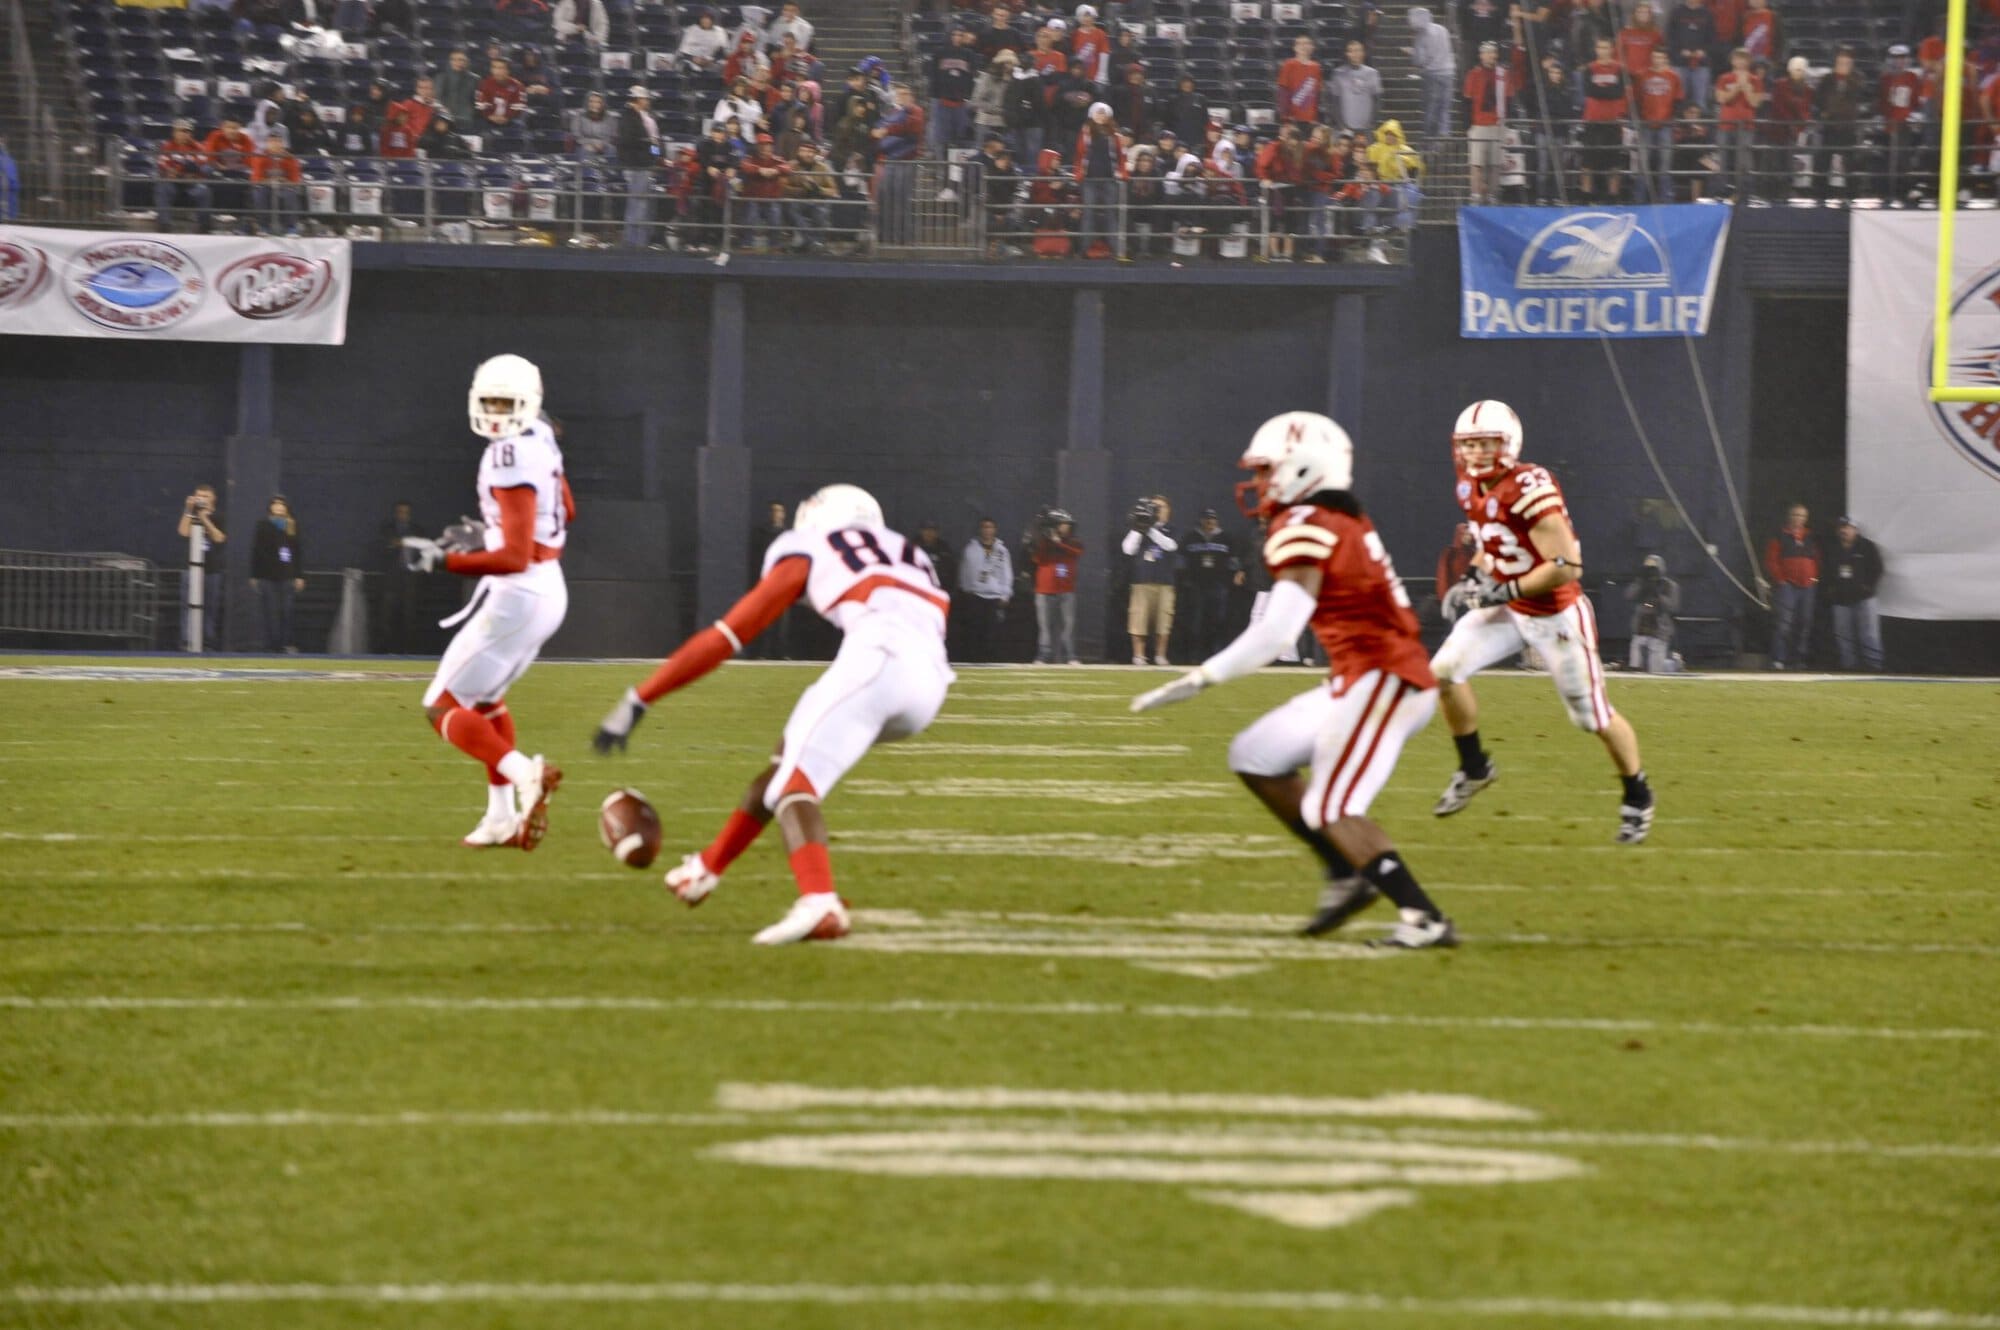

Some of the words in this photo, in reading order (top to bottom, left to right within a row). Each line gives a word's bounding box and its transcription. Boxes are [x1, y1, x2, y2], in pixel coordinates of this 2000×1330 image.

[1463, 290, 1627, 333] PACIFIC
[1632, 290, 1708, 333] LIF
[492, 444, 514, 468] 18
[1516, 467, 1552, 495] 33
